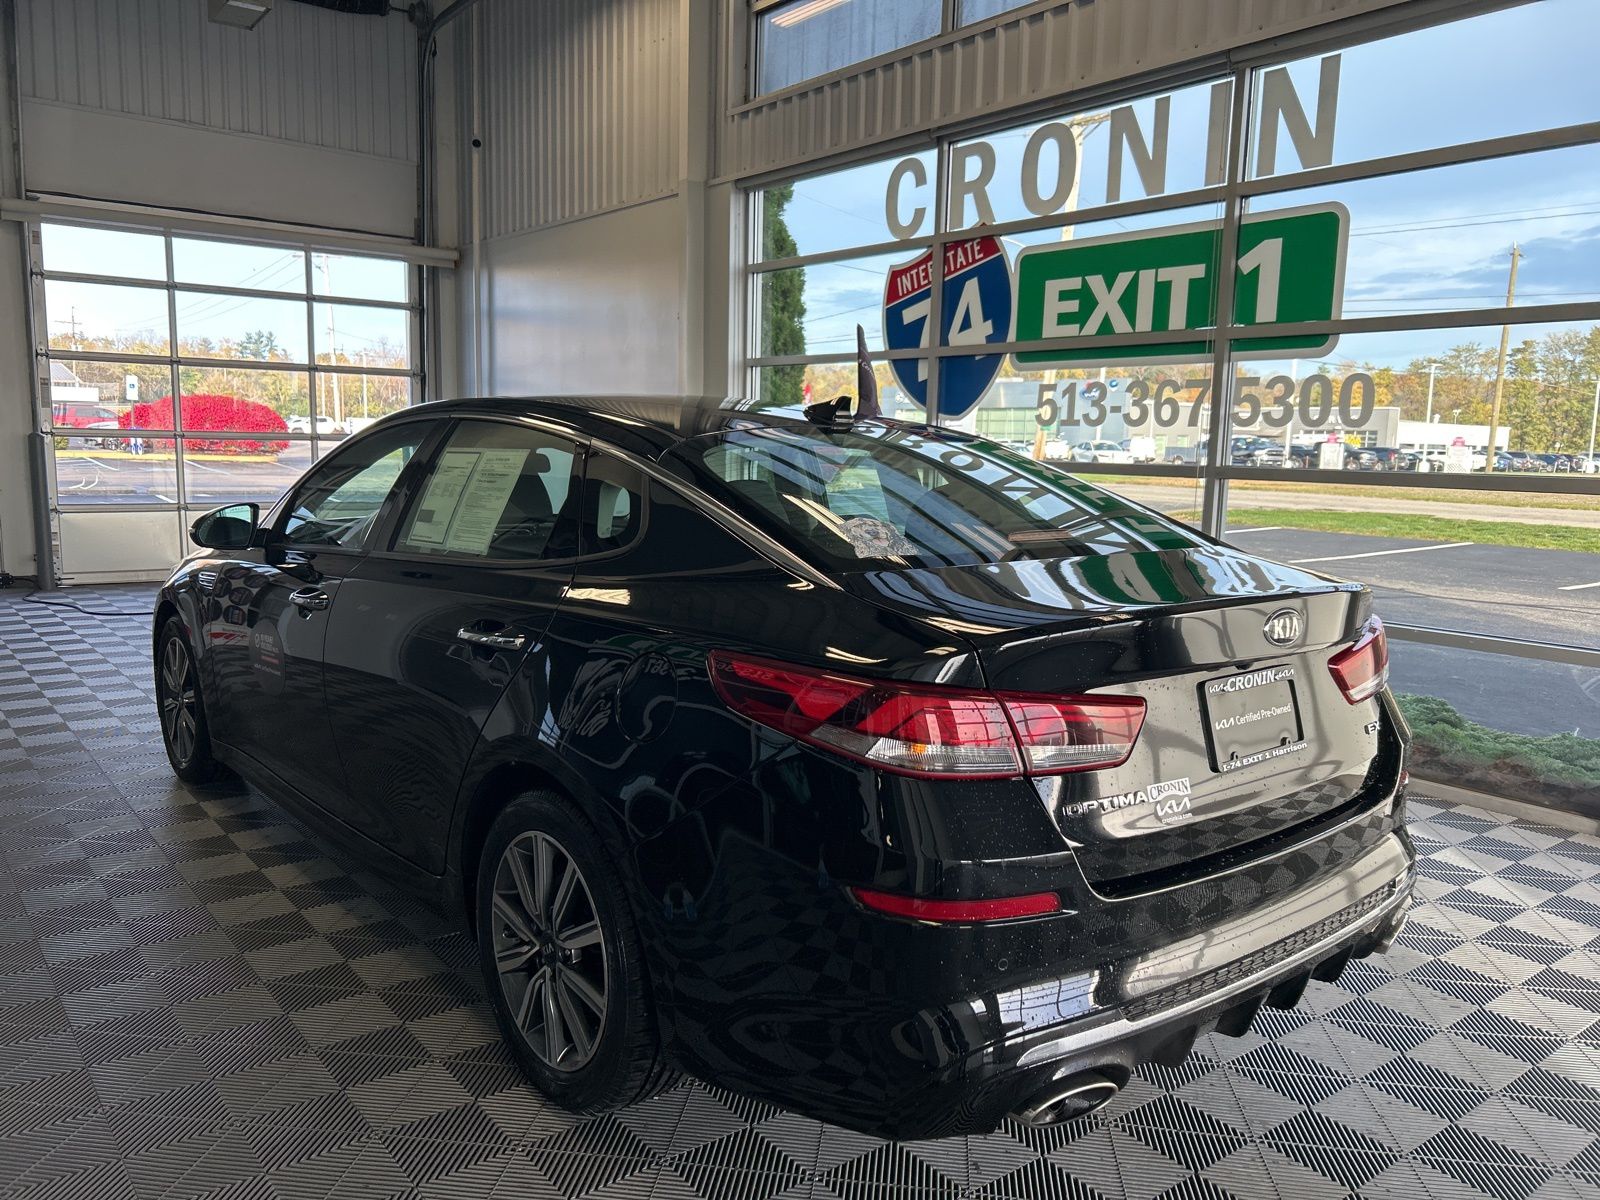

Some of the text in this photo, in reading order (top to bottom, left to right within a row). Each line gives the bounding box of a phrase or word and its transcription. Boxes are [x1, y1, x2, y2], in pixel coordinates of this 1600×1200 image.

[885, 54, 1342, 240] CRONIN
[897, 238, 984, 297] INTERTATE
[1043, 238, 1284, 338] EXIT 1
[902, 277, 994, 382] 74
[1035, 373, 1375, 428] 513-3675300
[1227, 670, 1276, 692] CRONIN
[1215, 704, 1292, 730] KIA Certified Pre-Owned
[1222, 742, 1308, 772] I-74 EXIT 1 Harrison
[1149, 779, 1189, 801] CRONIN
[1156, 797, 1191, 816] KIA
